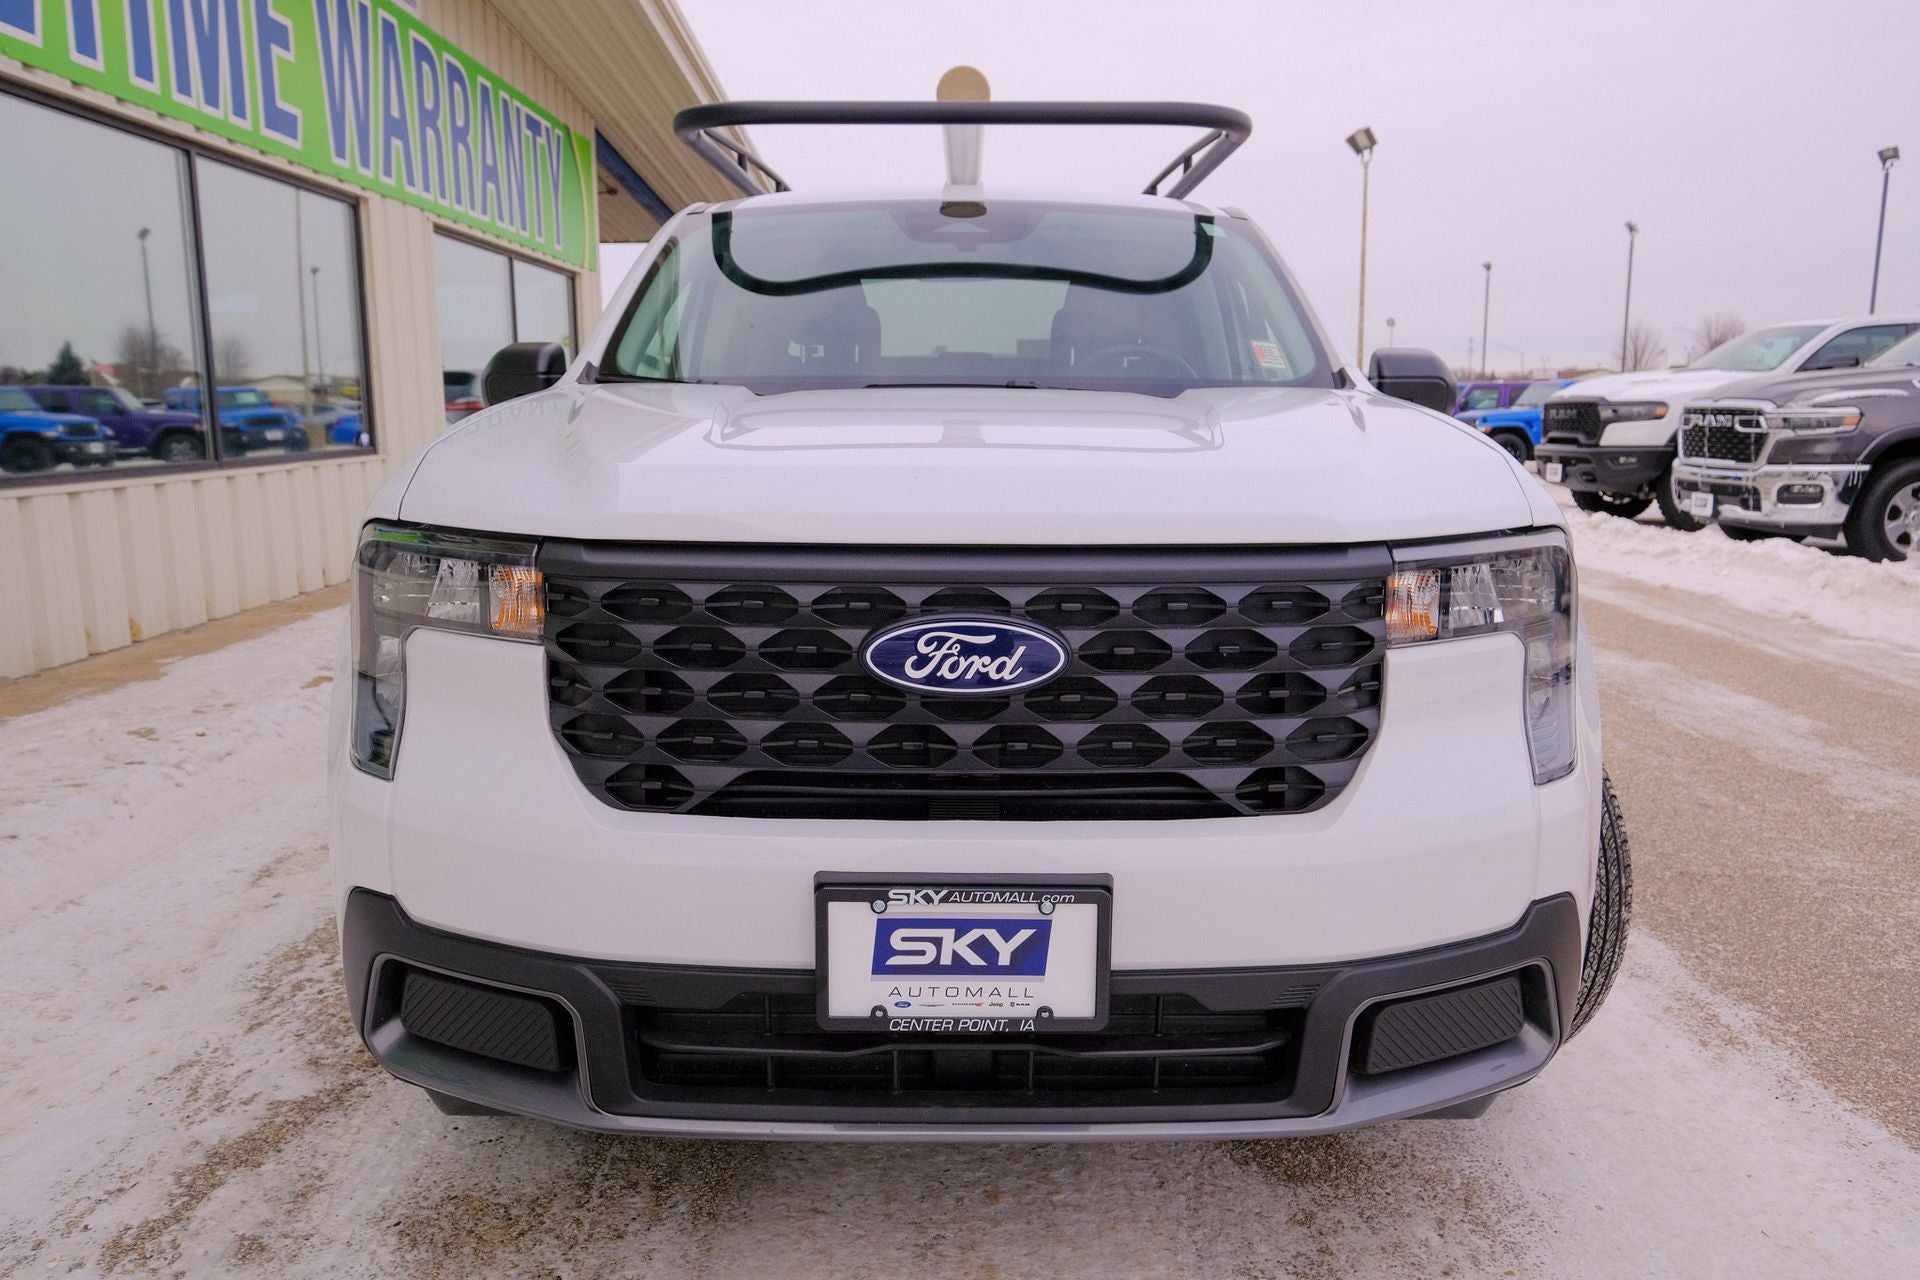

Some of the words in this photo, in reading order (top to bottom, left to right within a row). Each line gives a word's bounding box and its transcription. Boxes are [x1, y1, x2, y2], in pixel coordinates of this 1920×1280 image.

[313, 0, 563, 250] WARRANTY
[1681, 414, 1733, 429] RAM
[904, 631, 1027, 680] Ford
[885, 928, 1037, 966] SKY
[888, 986, 1034, 998] AUTOMALL
[889, 1018, 954, 1031] CENTER
[957, 1019, 1009, 1032] POINT,
[1019, 1019, 1035, 1031] IA
